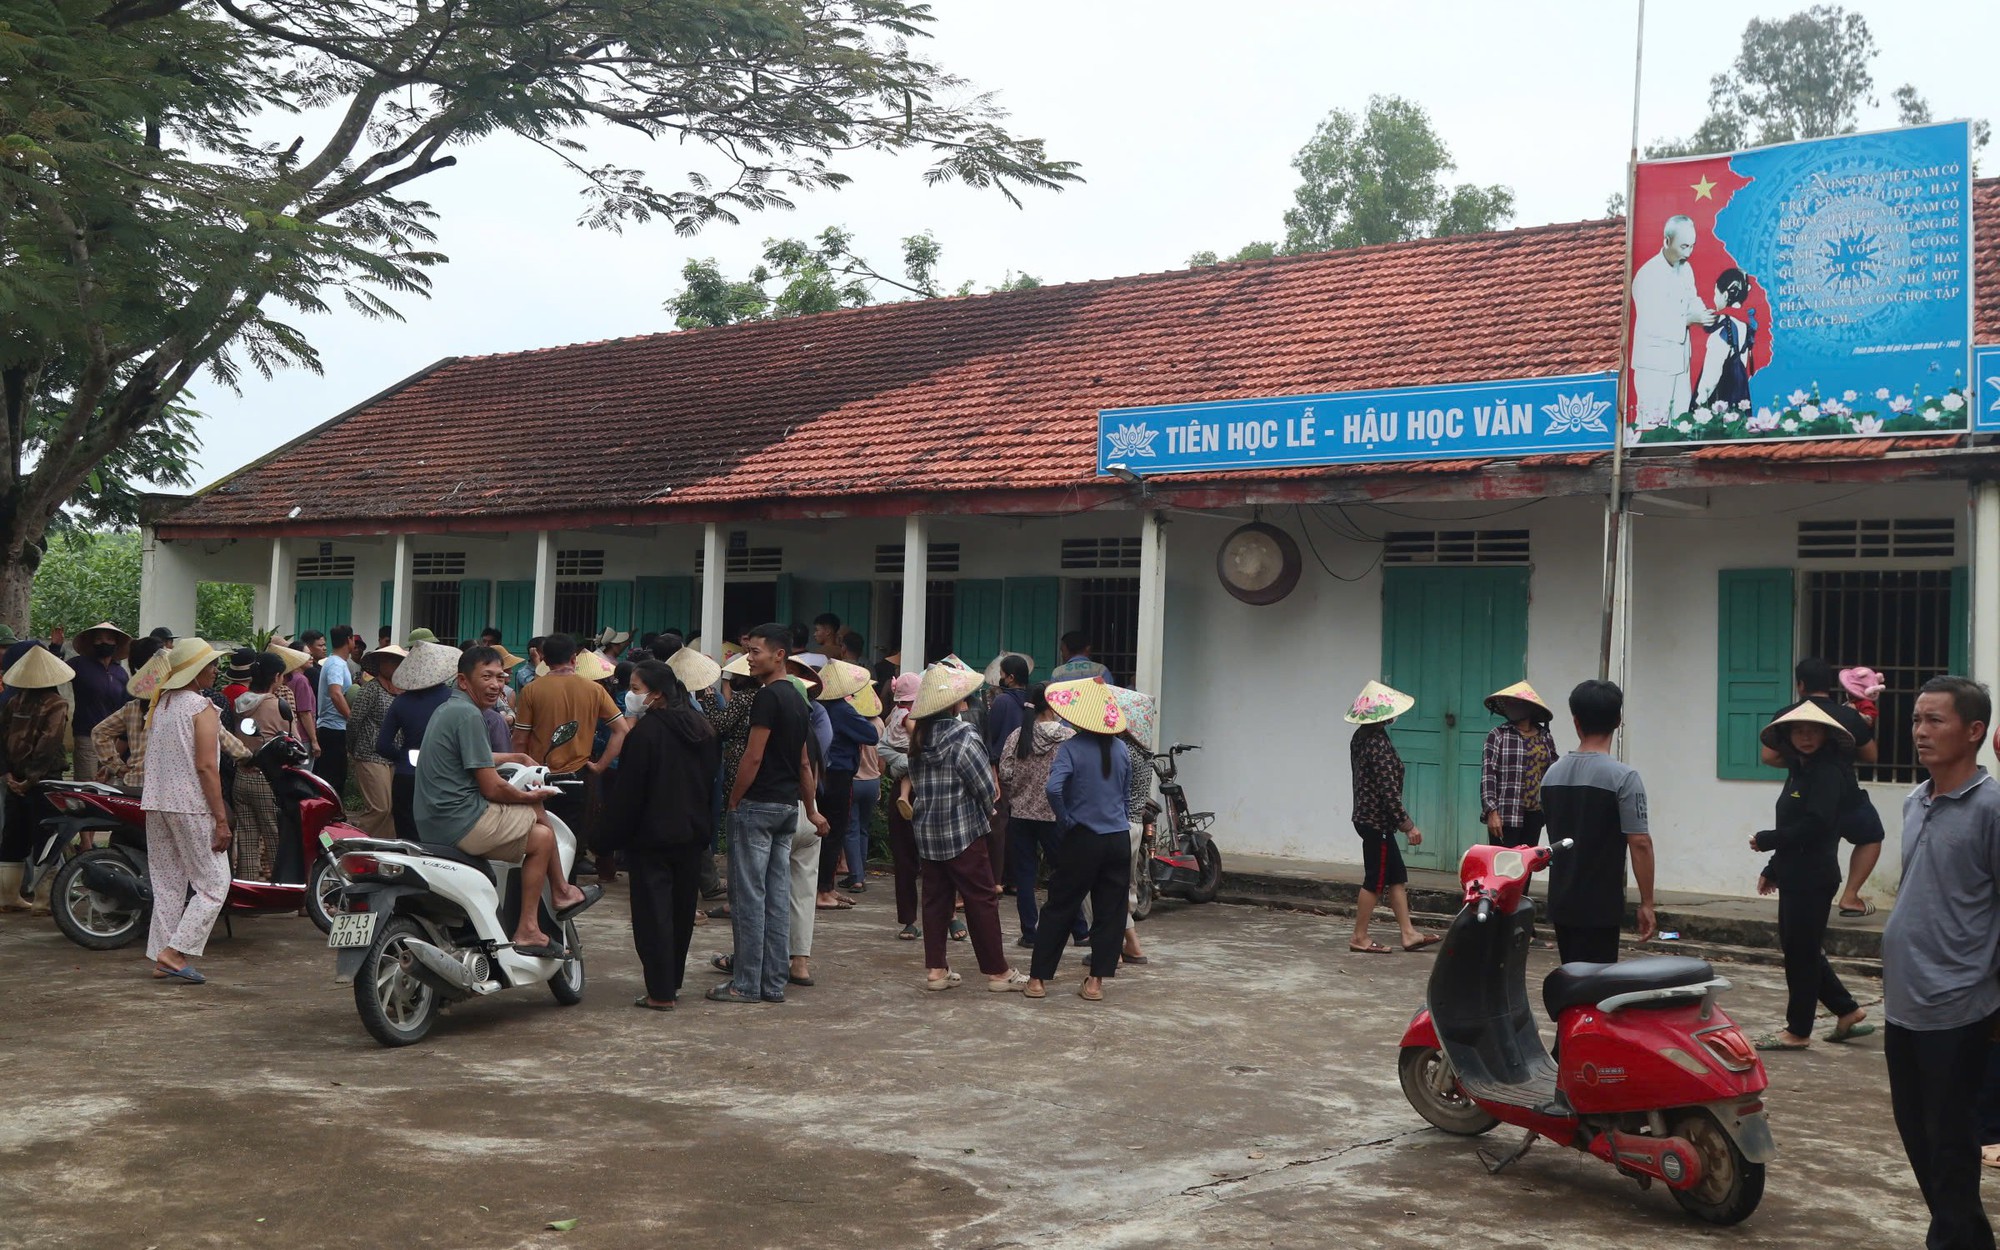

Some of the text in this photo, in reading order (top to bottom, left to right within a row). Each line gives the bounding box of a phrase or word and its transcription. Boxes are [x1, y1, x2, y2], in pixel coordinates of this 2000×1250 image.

[1881, 167, 1910, 183] VIỆT
[1911, 165, 1939, 179] NAM
[1941, 160, 1960, 176] CÓ
[1893, 185, 1923, 200] ĐẸP
[1931, 180, 1960, 195] HAY
[1880, 202, 1910, 217] VIỆT
[1911, 200, 1939, 215] NAM
[1941, 196, 1960, 211] CÓ
[1895, 219, 1939, 235] QUANG
[1820, 245, 1841, 258] VAI
[1934, 251, 1960, 265] HAY
[1931, 266, 1960, 284] MỘT
[1905, 288, 1932, 304] HỌC
[1934, 284, 1960, 301] TẬP
[1227, 420, 1278, 456] HỌC
[1287, 406, 1316, 447] LỄ
[1343, 407, 1398, 449] HẬU
[1407, 408, 1464, 446] HỌC
[1473, 398, 1533, 437] VĂN
[422, 860, 458, 871] VISION
[338, 915, 370, 930] 37-L3
[330, 930, 369, 946] 020.31
